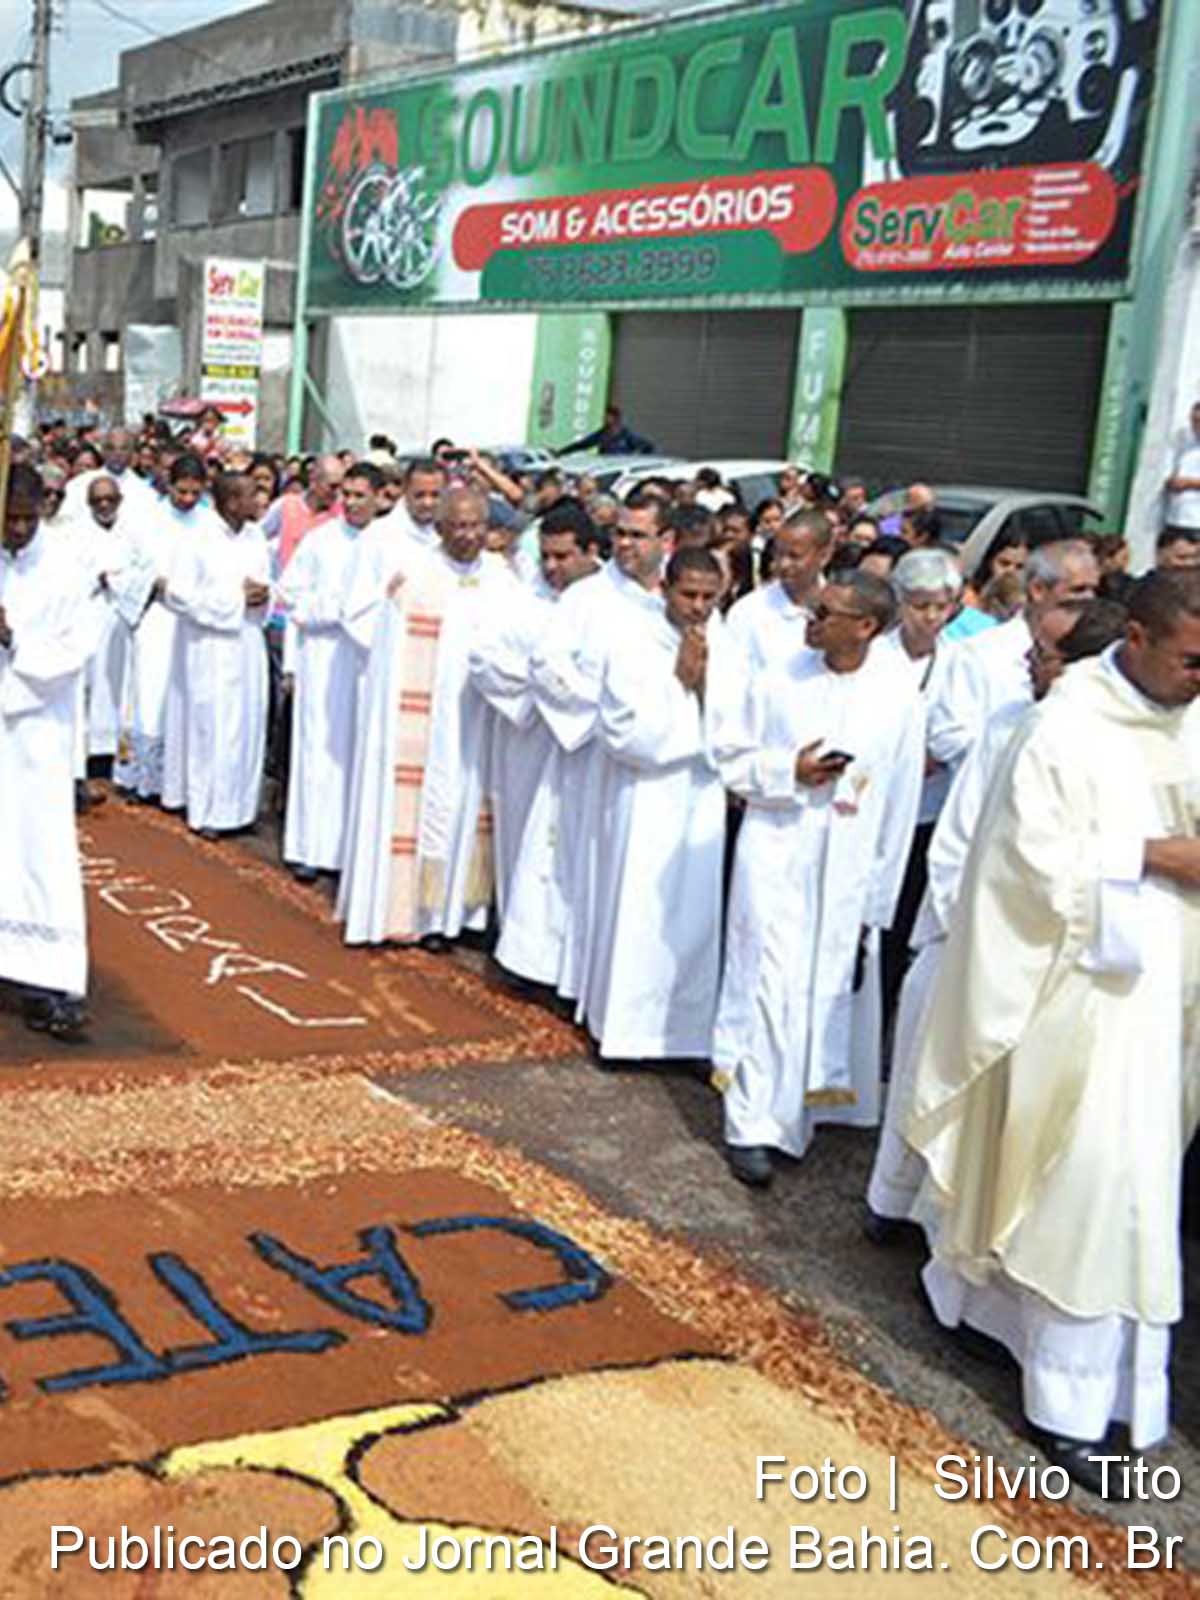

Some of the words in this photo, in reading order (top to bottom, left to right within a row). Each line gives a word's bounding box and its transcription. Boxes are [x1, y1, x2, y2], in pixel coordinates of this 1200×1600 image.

[418, 6, 908, 193] SOUNDCAR
[501, 212, 559, 243] SOM
[565, 205, 588, 238] &
[591, 184, 794, 236] ACESSÓRIOS
